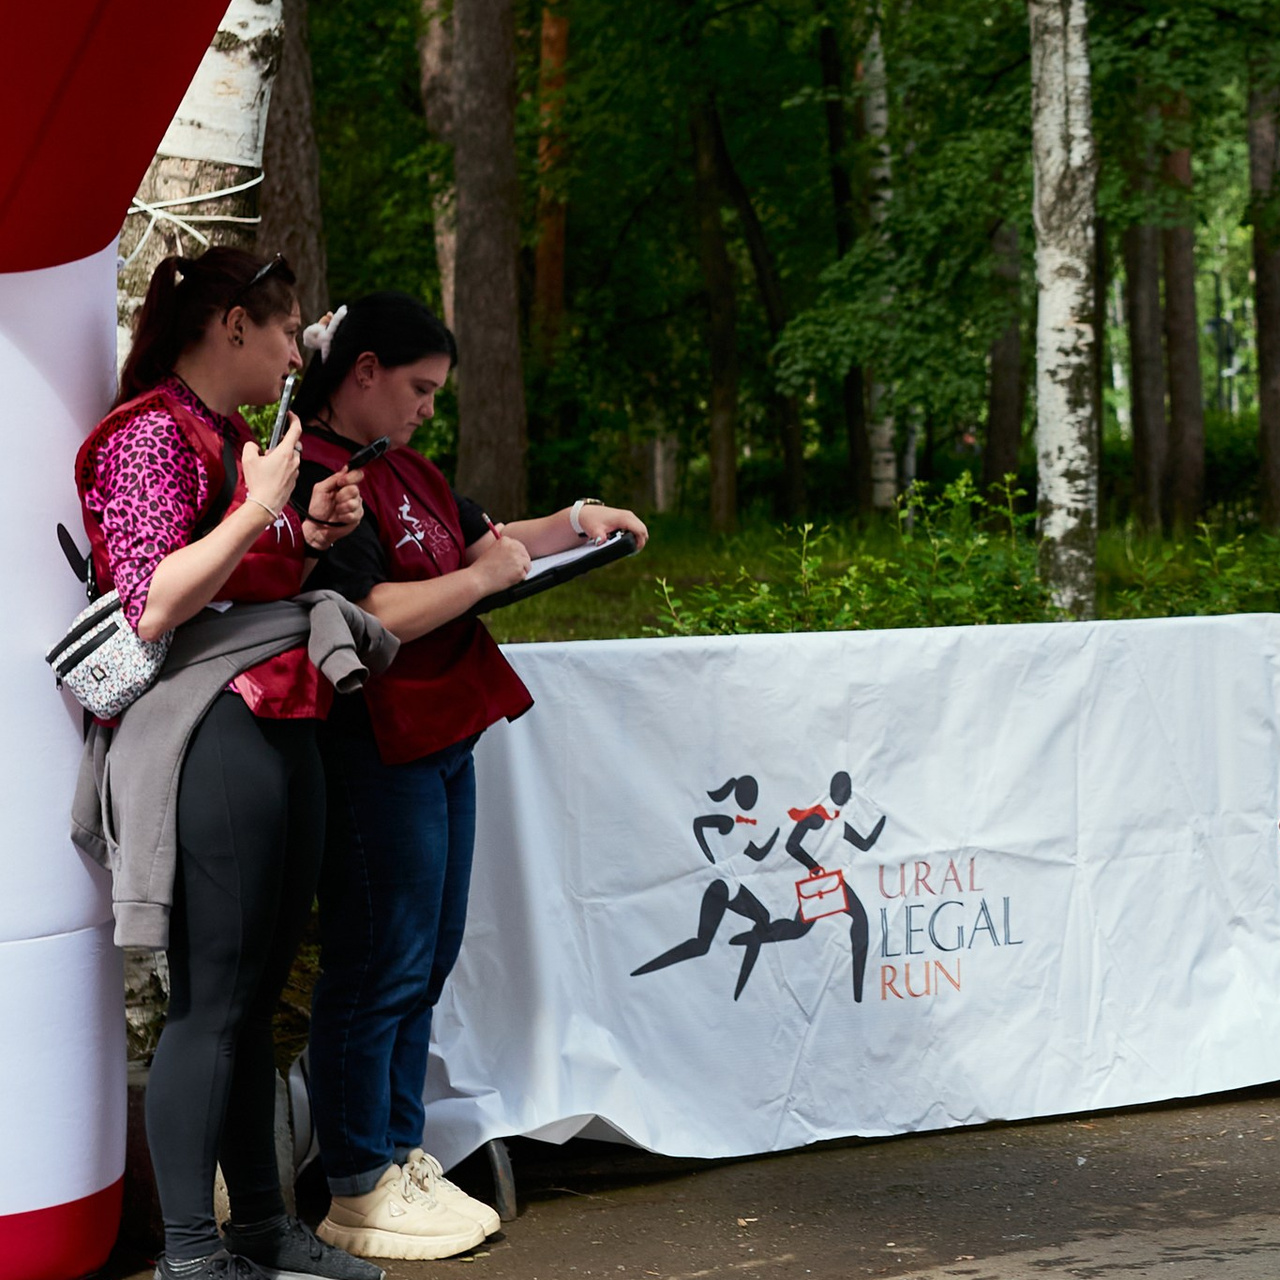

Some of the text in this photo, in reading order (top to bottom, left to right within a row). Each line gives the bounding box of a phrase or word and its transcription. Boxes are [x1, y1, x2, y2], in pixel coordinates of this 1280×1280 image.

[878, 857, 984, 898] URAL
[880, 896, 1024, 957] LEGAL
[880, 958, 961, 1001] RUN
